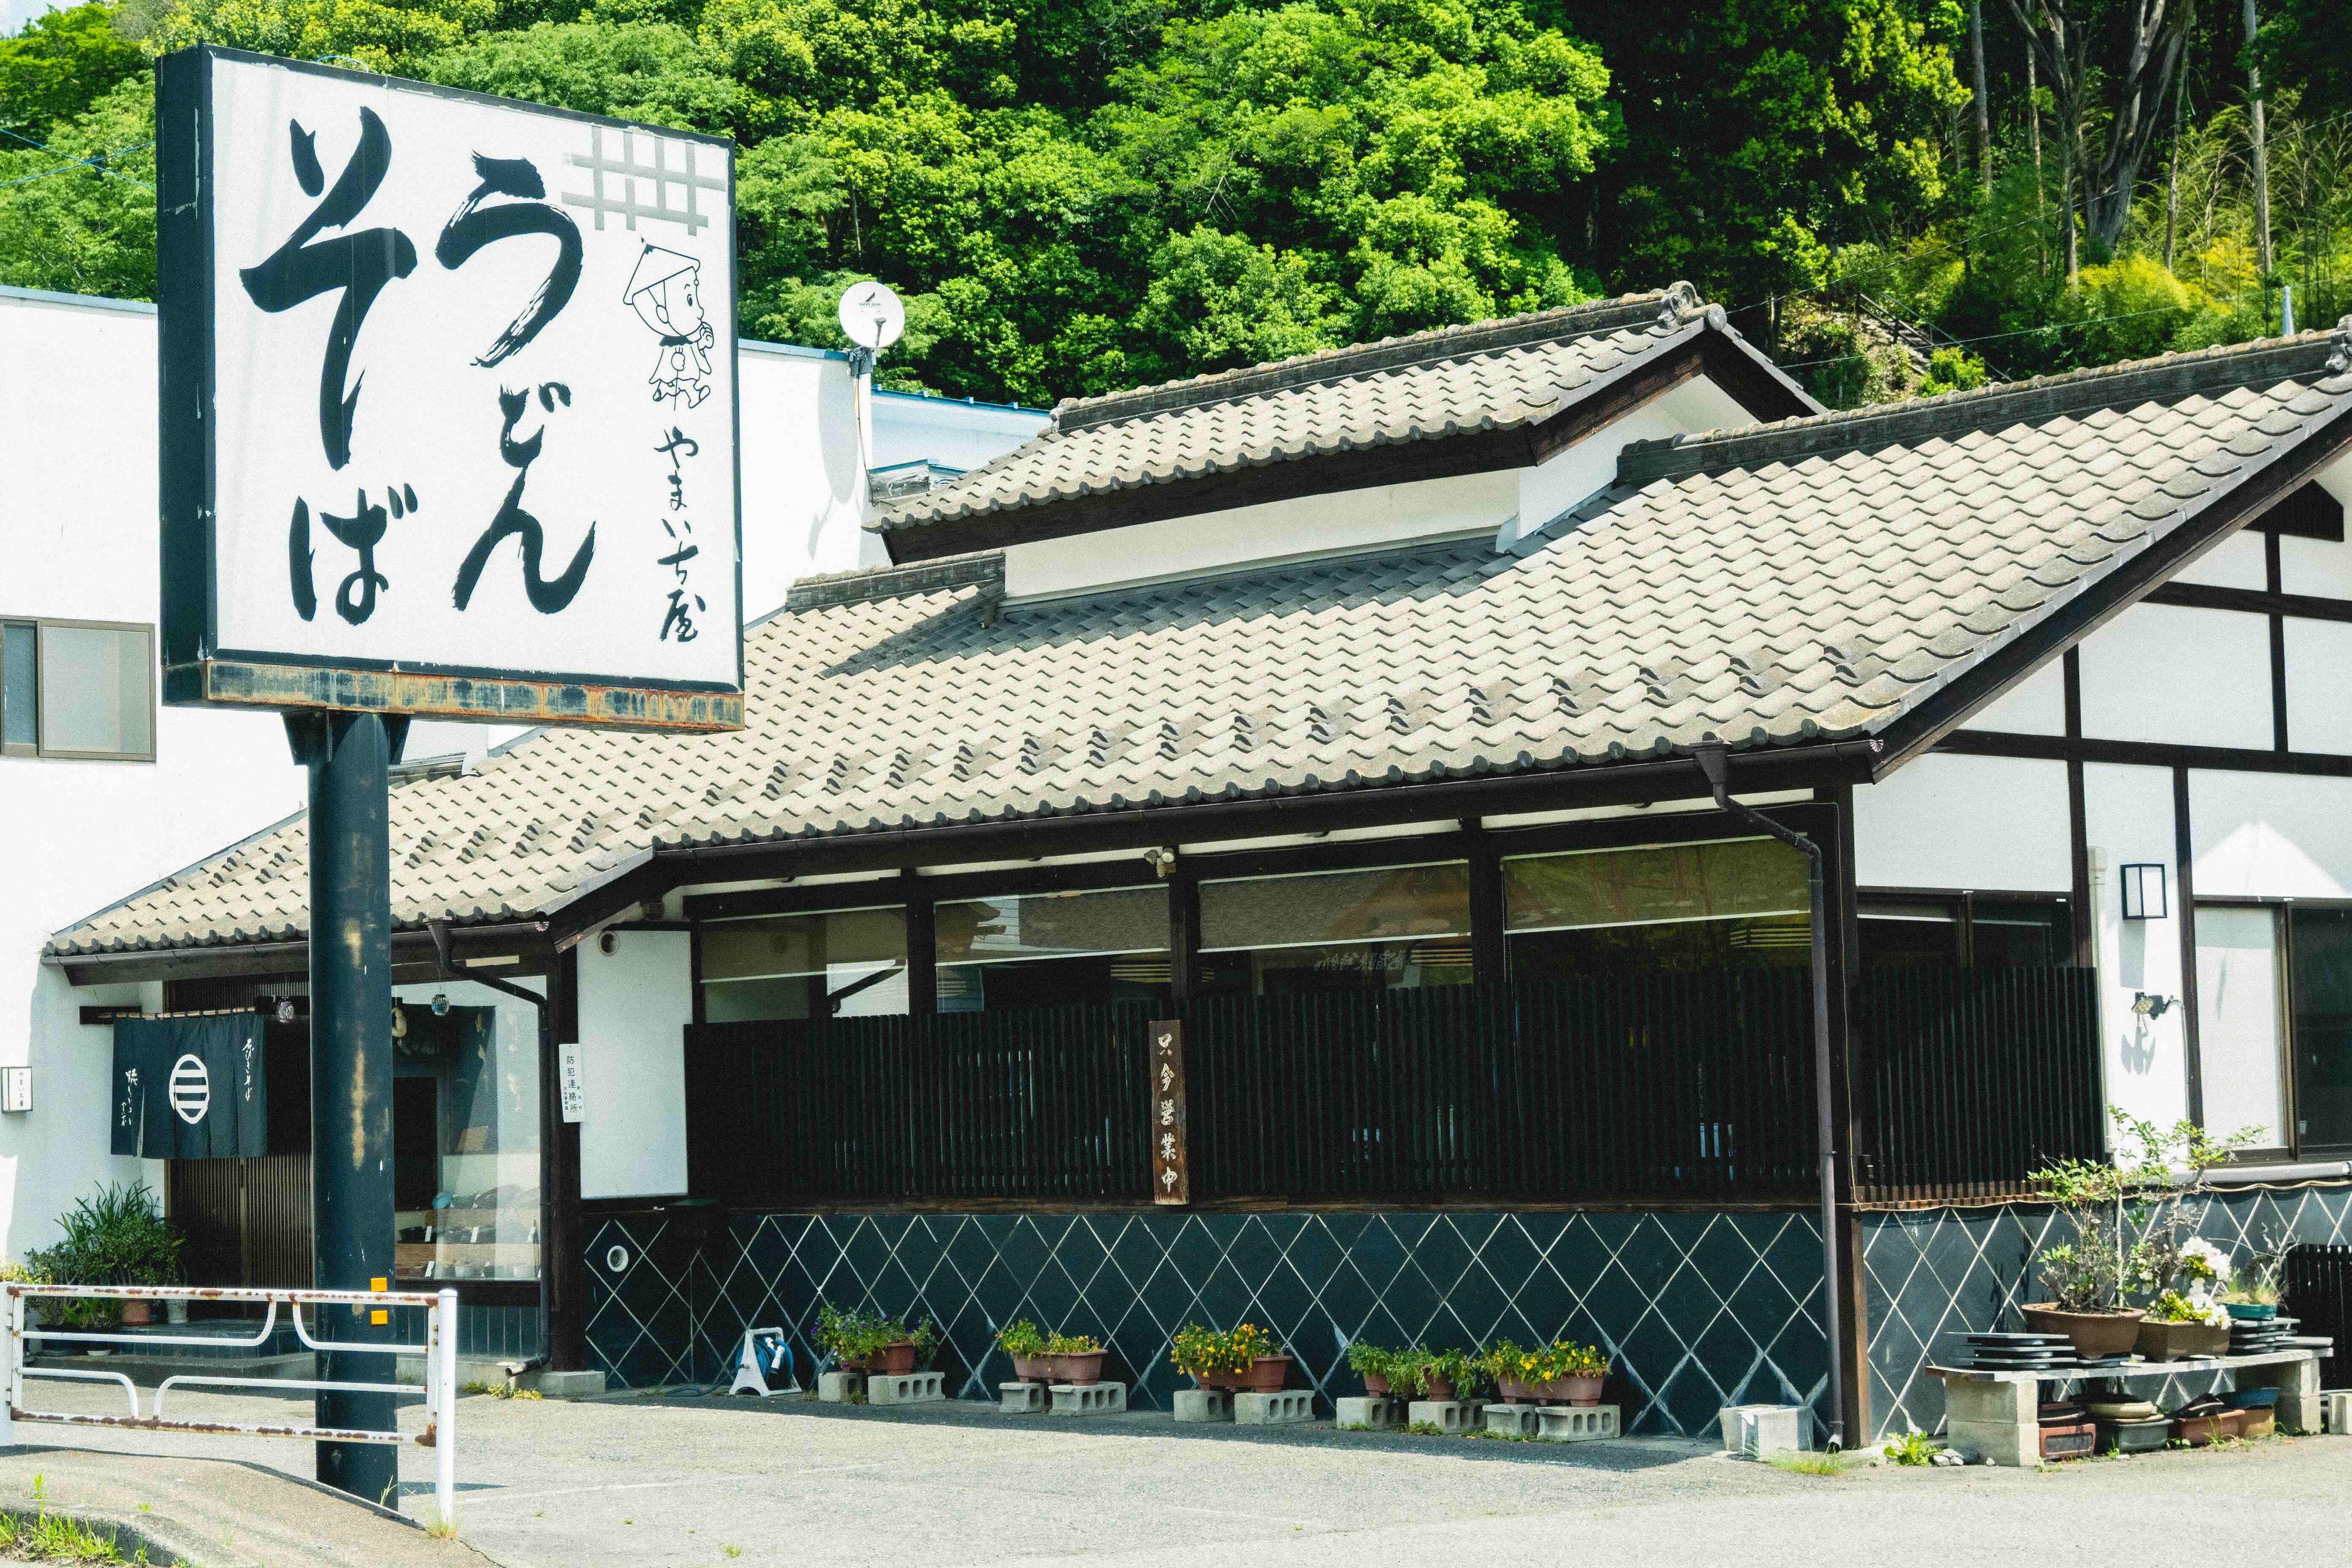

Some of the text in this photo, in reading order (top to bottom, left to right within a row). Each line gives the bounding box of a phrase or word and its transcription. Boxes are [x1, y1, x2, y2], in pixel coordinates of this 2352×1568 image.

[239, 106, 418, 626] そば
[435, 150, 596, 615] うどん
[654, 426, 706, 642] やまいち屋
[566, 1055, 578, 1113] 防犯連絡所
[1157, 1033, 1178, 1193] 只今営業中
